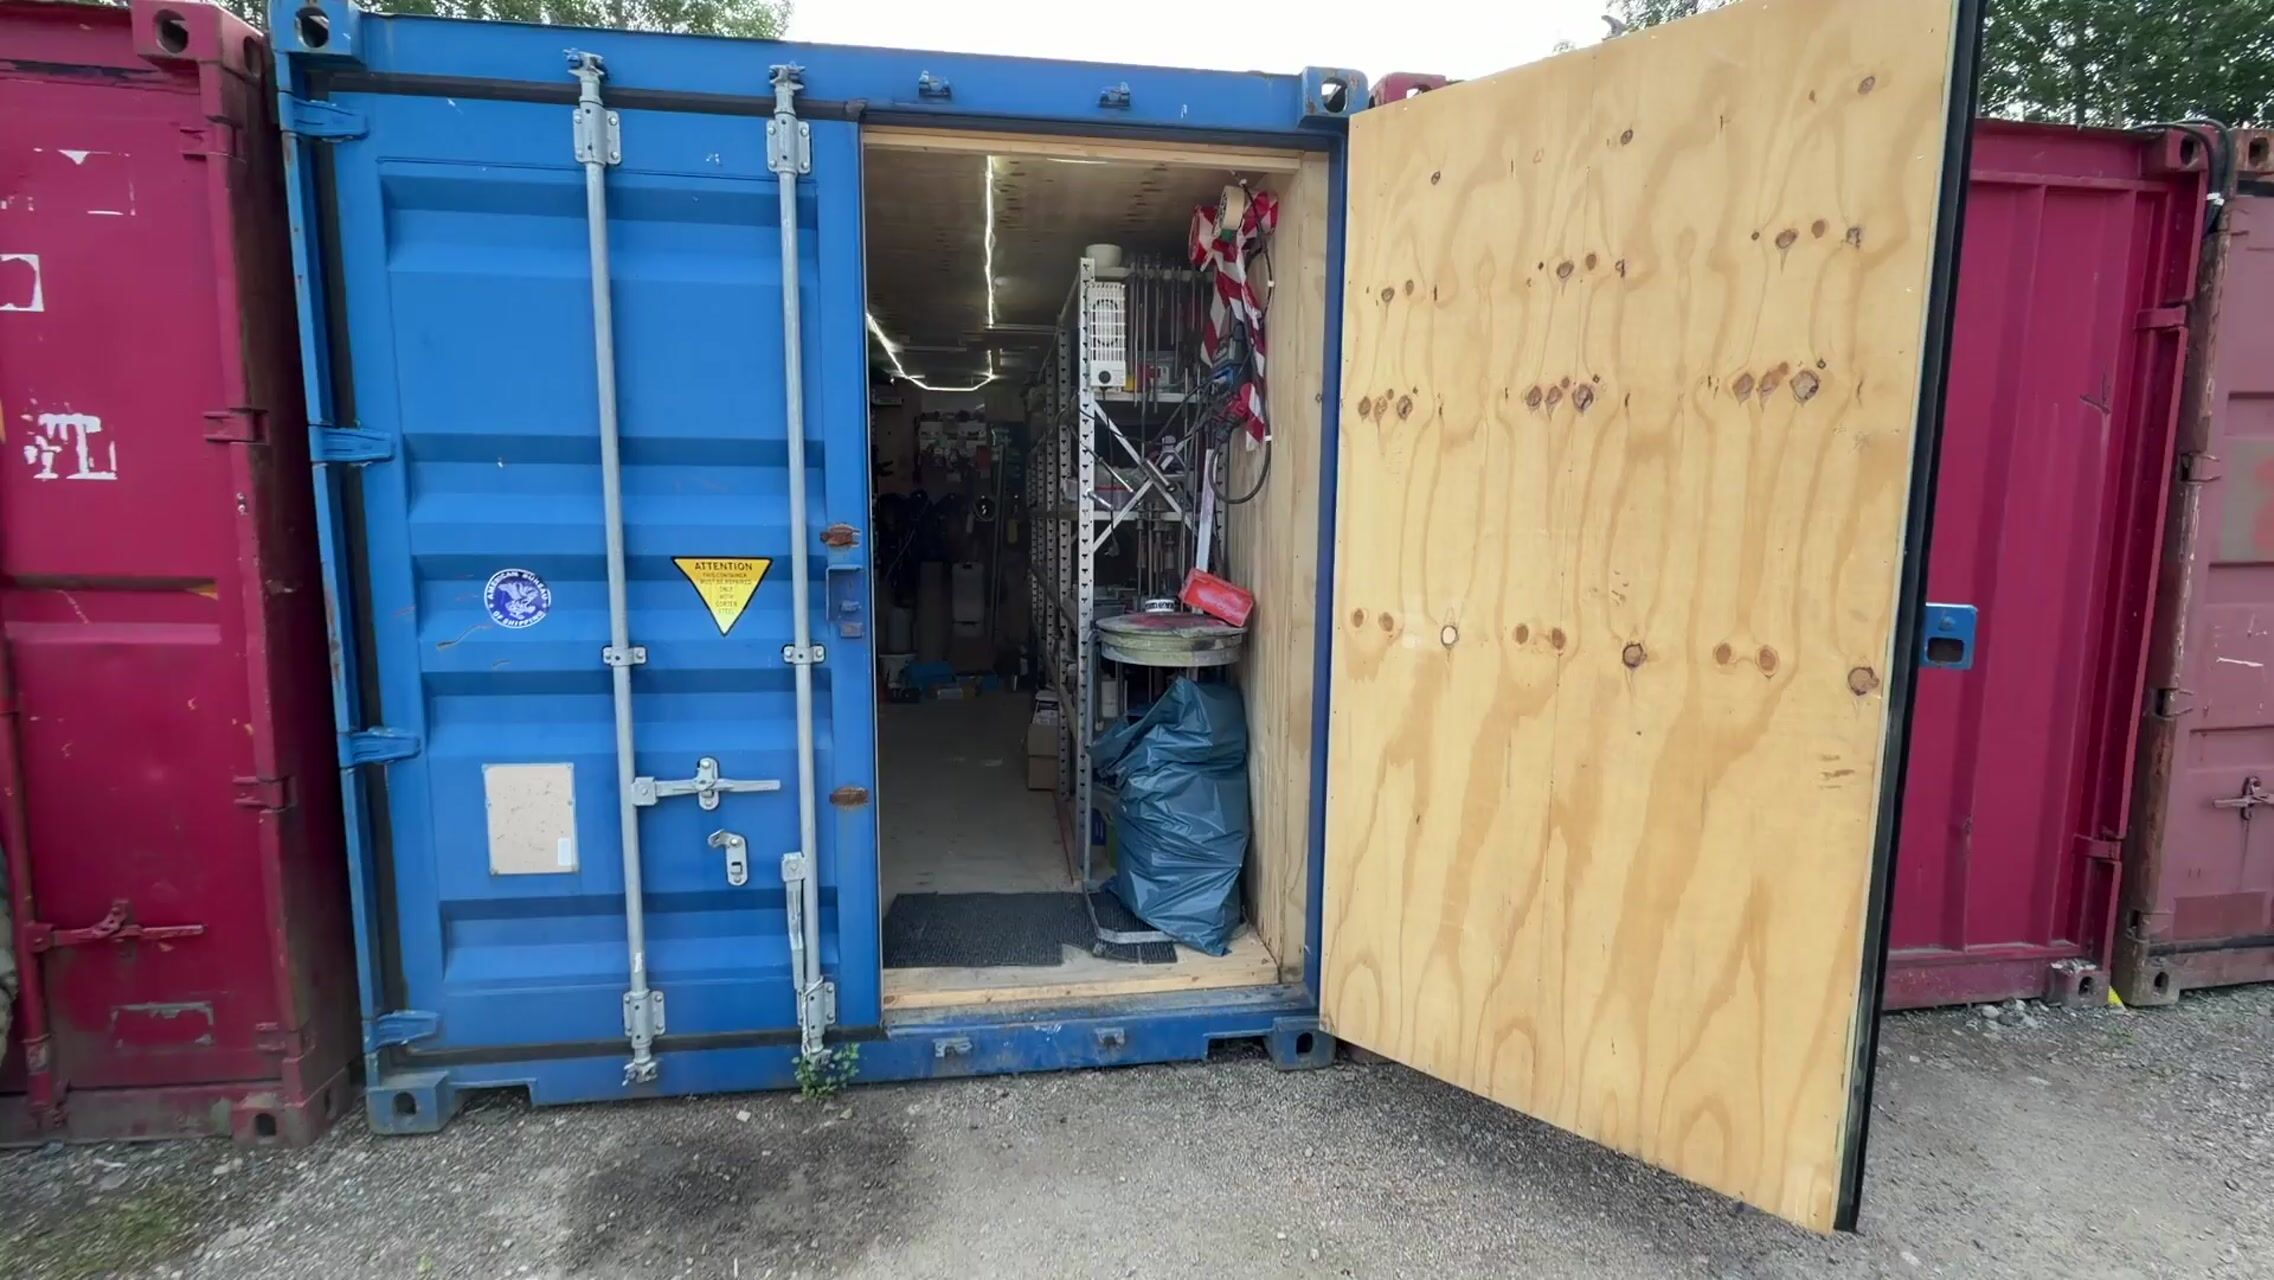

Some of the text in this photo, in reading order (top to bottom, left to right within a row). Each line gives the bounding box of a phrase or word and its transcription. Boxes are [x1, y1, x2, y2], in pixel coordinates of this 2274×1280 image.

[695, 562, 753, 571] ATTENTION
[487, 571, 548, 600] AMERICAN BUREAU
[502, 610, 545, 626] SHIPPING
